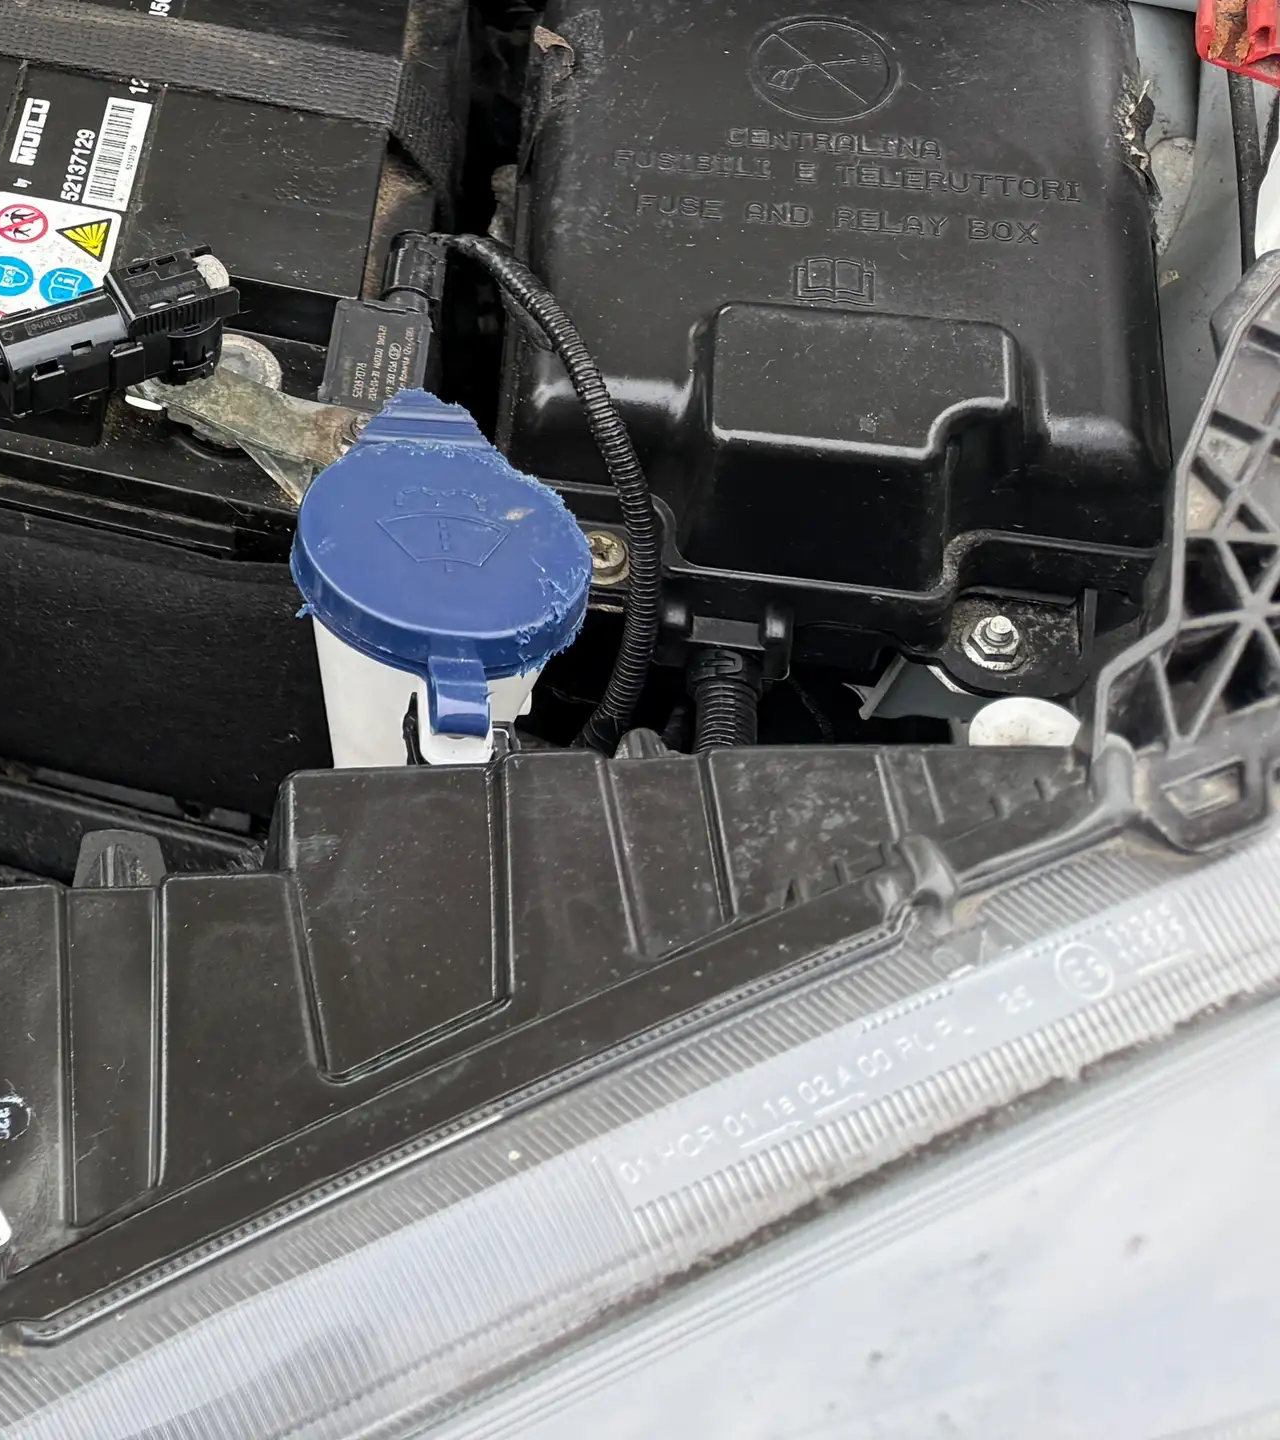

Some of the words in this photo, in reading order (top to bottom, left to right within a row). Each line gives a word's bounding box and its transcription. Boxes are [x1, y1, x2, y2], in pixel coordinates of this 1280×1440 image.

[59, 126, 96, 203] 52137129
[726, 127, 943, 160] CENTRALINA
[614, 149, 772, 180] FUSIBILI
[794, 161, 820, 183] E
[835, 162, 1081, 203] TELERUTTORI
[639, 193, 723, 220] FUSE
[745, 202, 810, 227] AND
[834, 208, 946, 238] RELAY
[967, 218, 1039, 245] BOX
